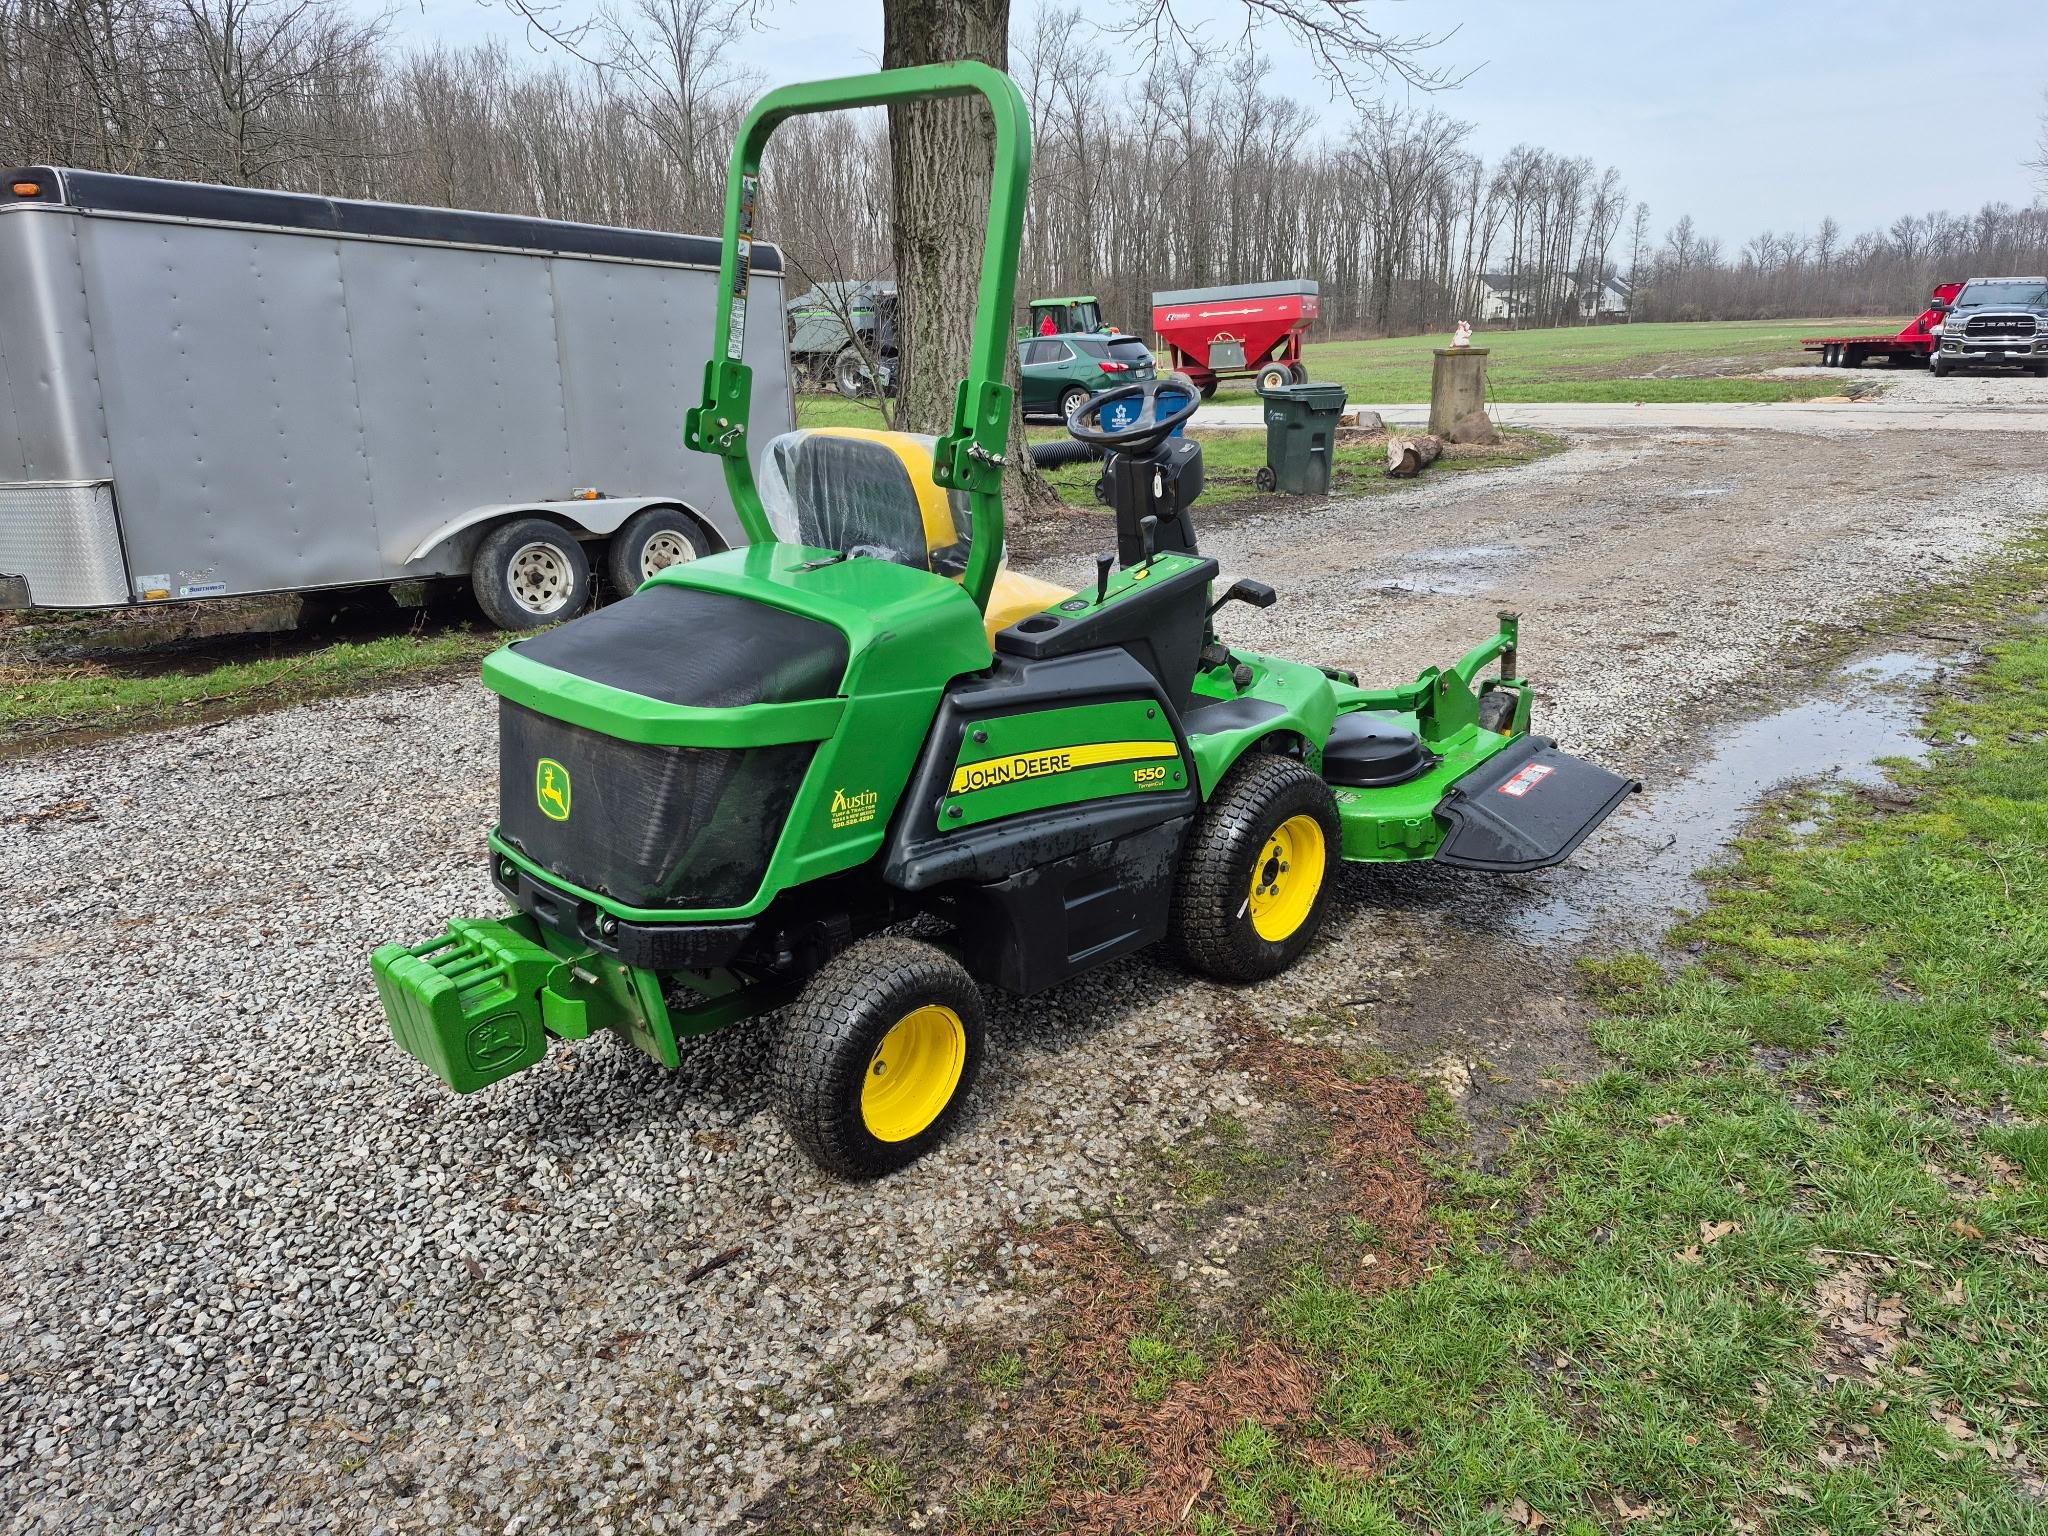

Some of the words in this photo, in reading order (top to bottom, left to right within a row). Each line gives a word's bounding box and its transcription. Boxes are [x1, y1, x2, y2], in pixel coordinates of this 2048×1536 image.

[960, 764, 1010, 791] JOHN
[1013, 753, 1072, 777] DEERE
[1133, 766, 1166, 783] 1550
[831, 788, 878, 813] Austin
